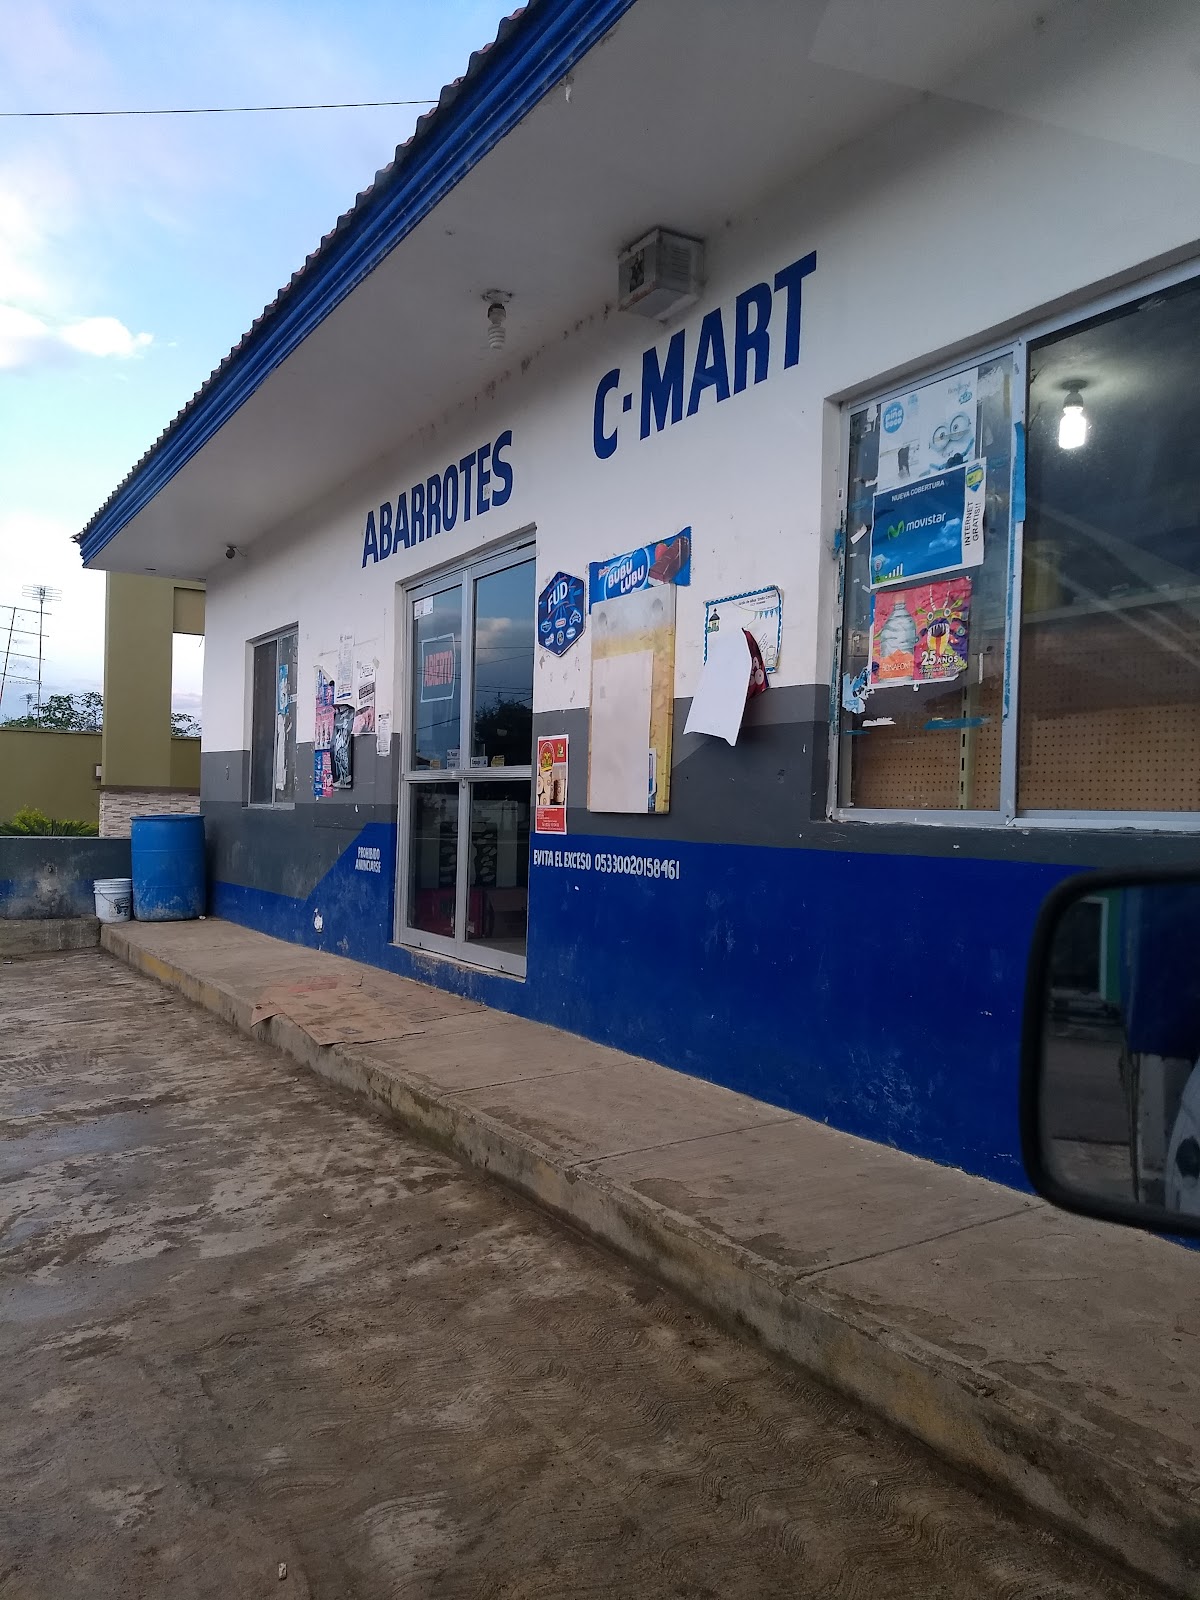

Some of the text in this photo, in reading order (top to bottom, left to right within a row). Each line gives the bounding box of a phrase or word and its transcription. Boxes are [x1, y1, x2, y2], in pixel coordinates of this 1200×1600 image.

[362, 430, 513, 568] ABARROTES
[891, 480, 945, 502] NUEVA COBERTURA
[906, 512, 947, 532] movistar
[964, 502, 973, 546] INTERNET
[608, 559, 633, 589] BUBU
[620, 565, 645, 593] LUBU
[547, 581, 568, 614] FUD
[424, 650, 453, 687] ABIERTO
[921, 650, 959, 666] 25 AÑOS
[533, 849, 680, 880] EVITA EL EXCESO 05330020158461
